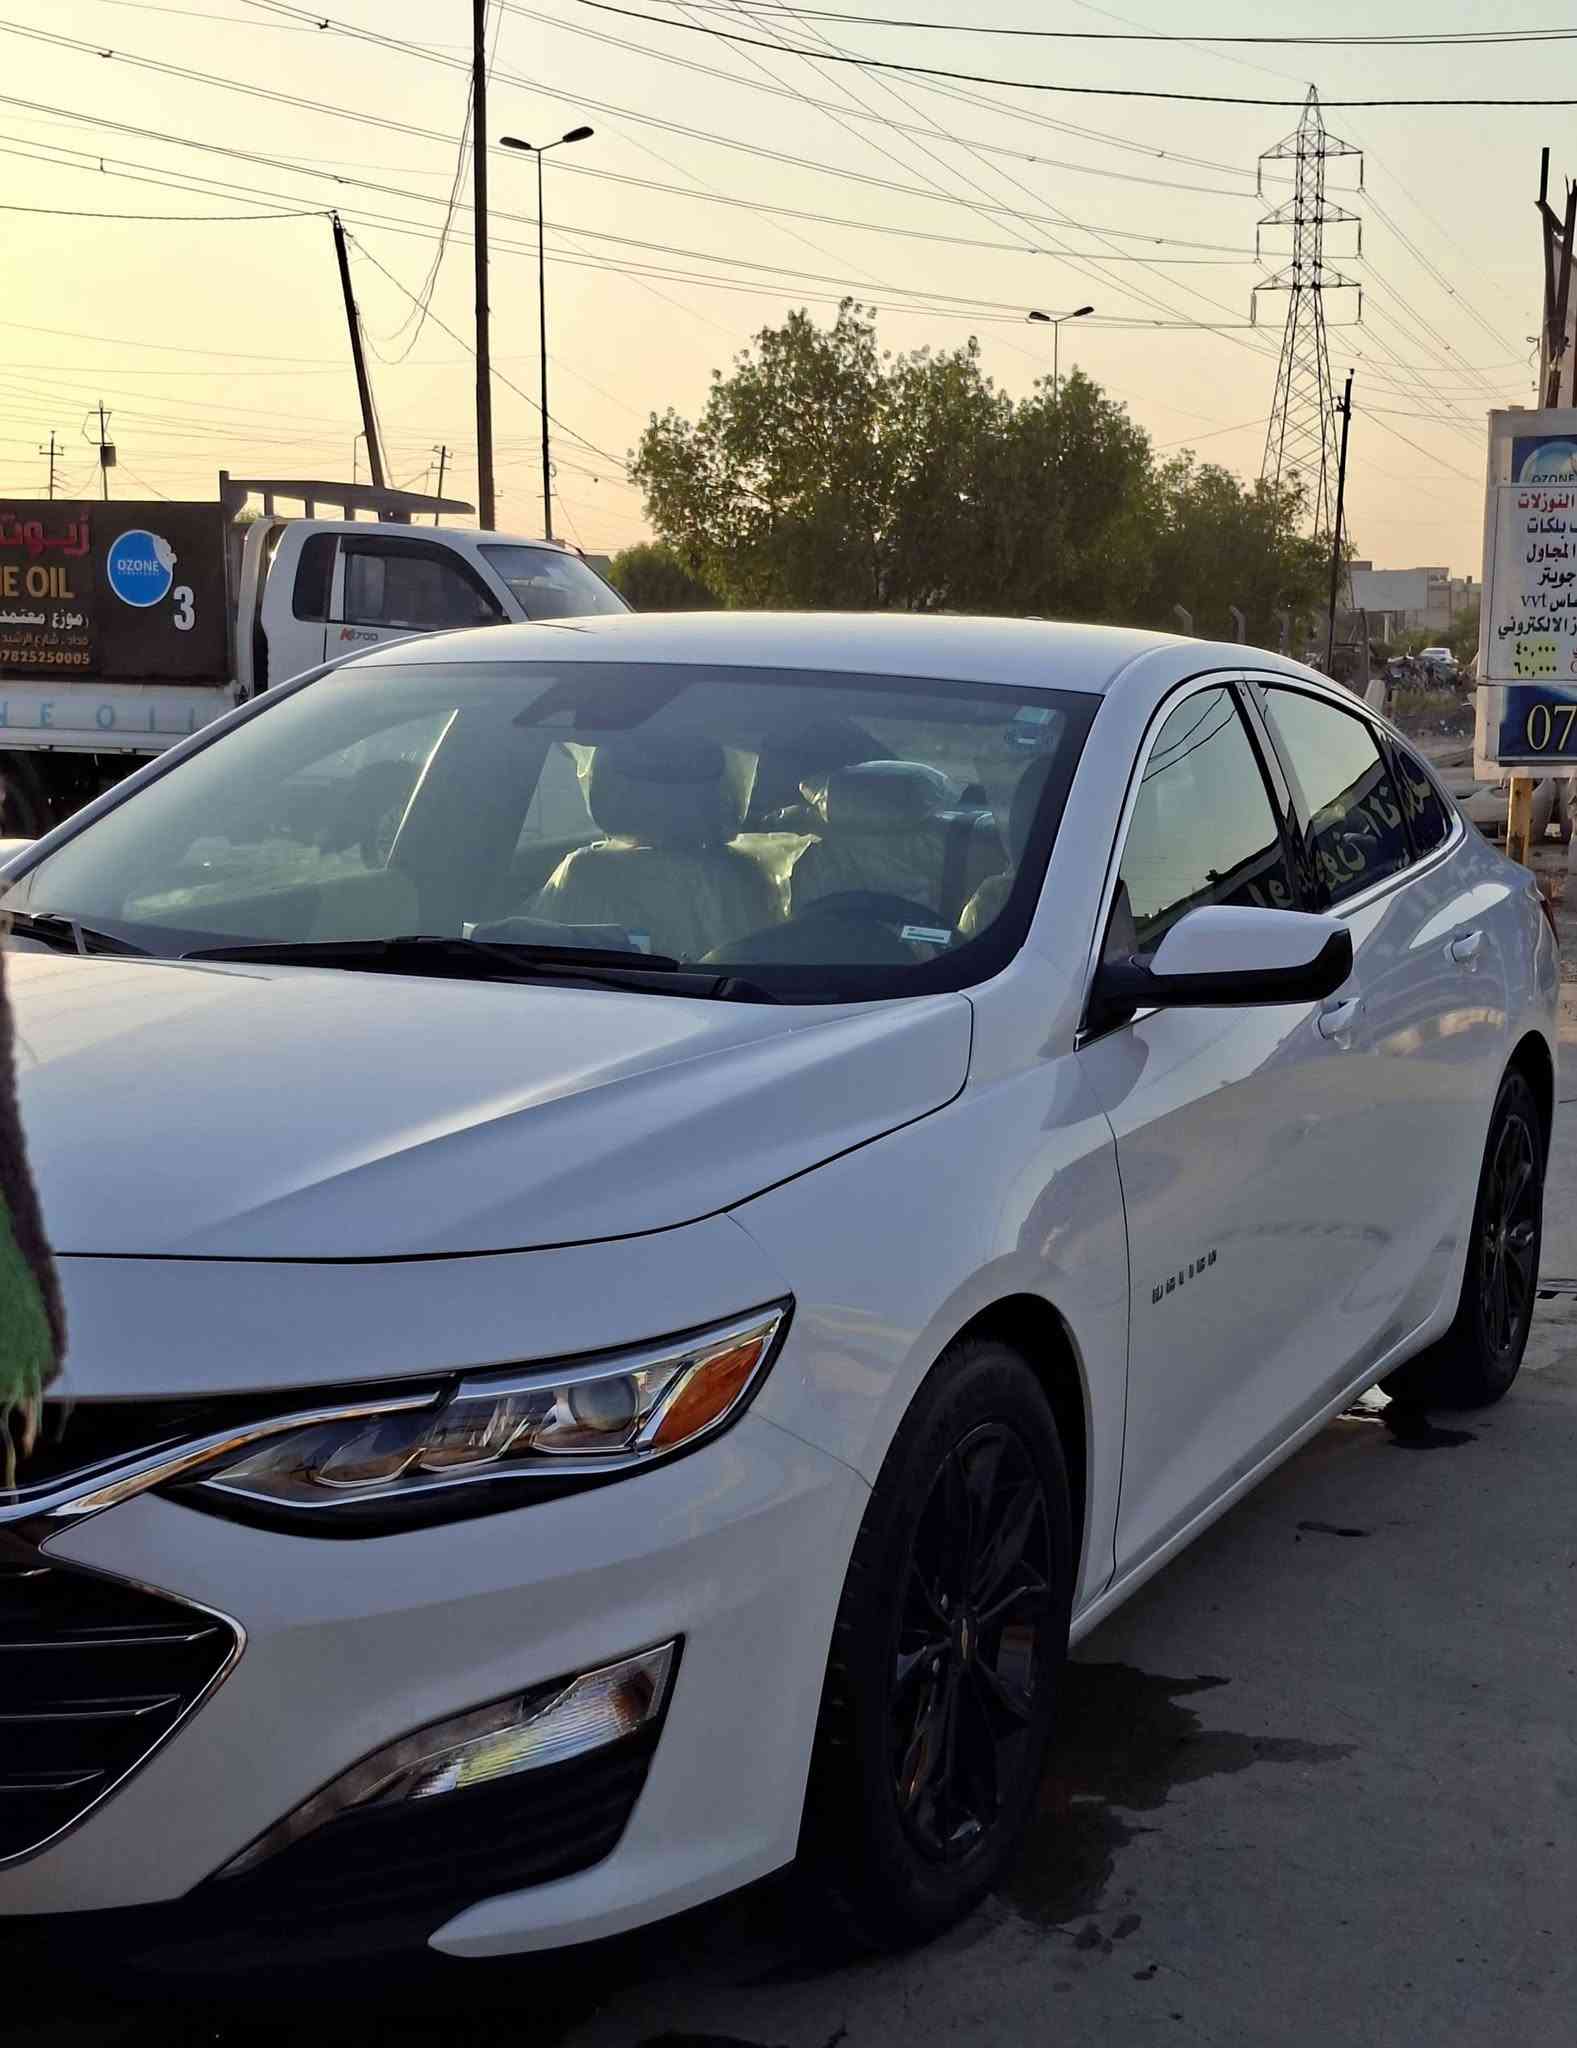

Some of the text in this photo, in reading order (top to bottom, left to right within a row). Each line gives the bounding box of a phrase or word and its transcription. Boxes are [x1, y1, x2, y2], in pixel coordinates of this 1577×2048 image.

[0, 566, 75, 599] E OIL
[117, 559, 161, 573] OZONE
[173, 585, 195, 631] 3
[0, 649, 90, 665] 7825250005
[1527, 704, 1577, 751] 07
